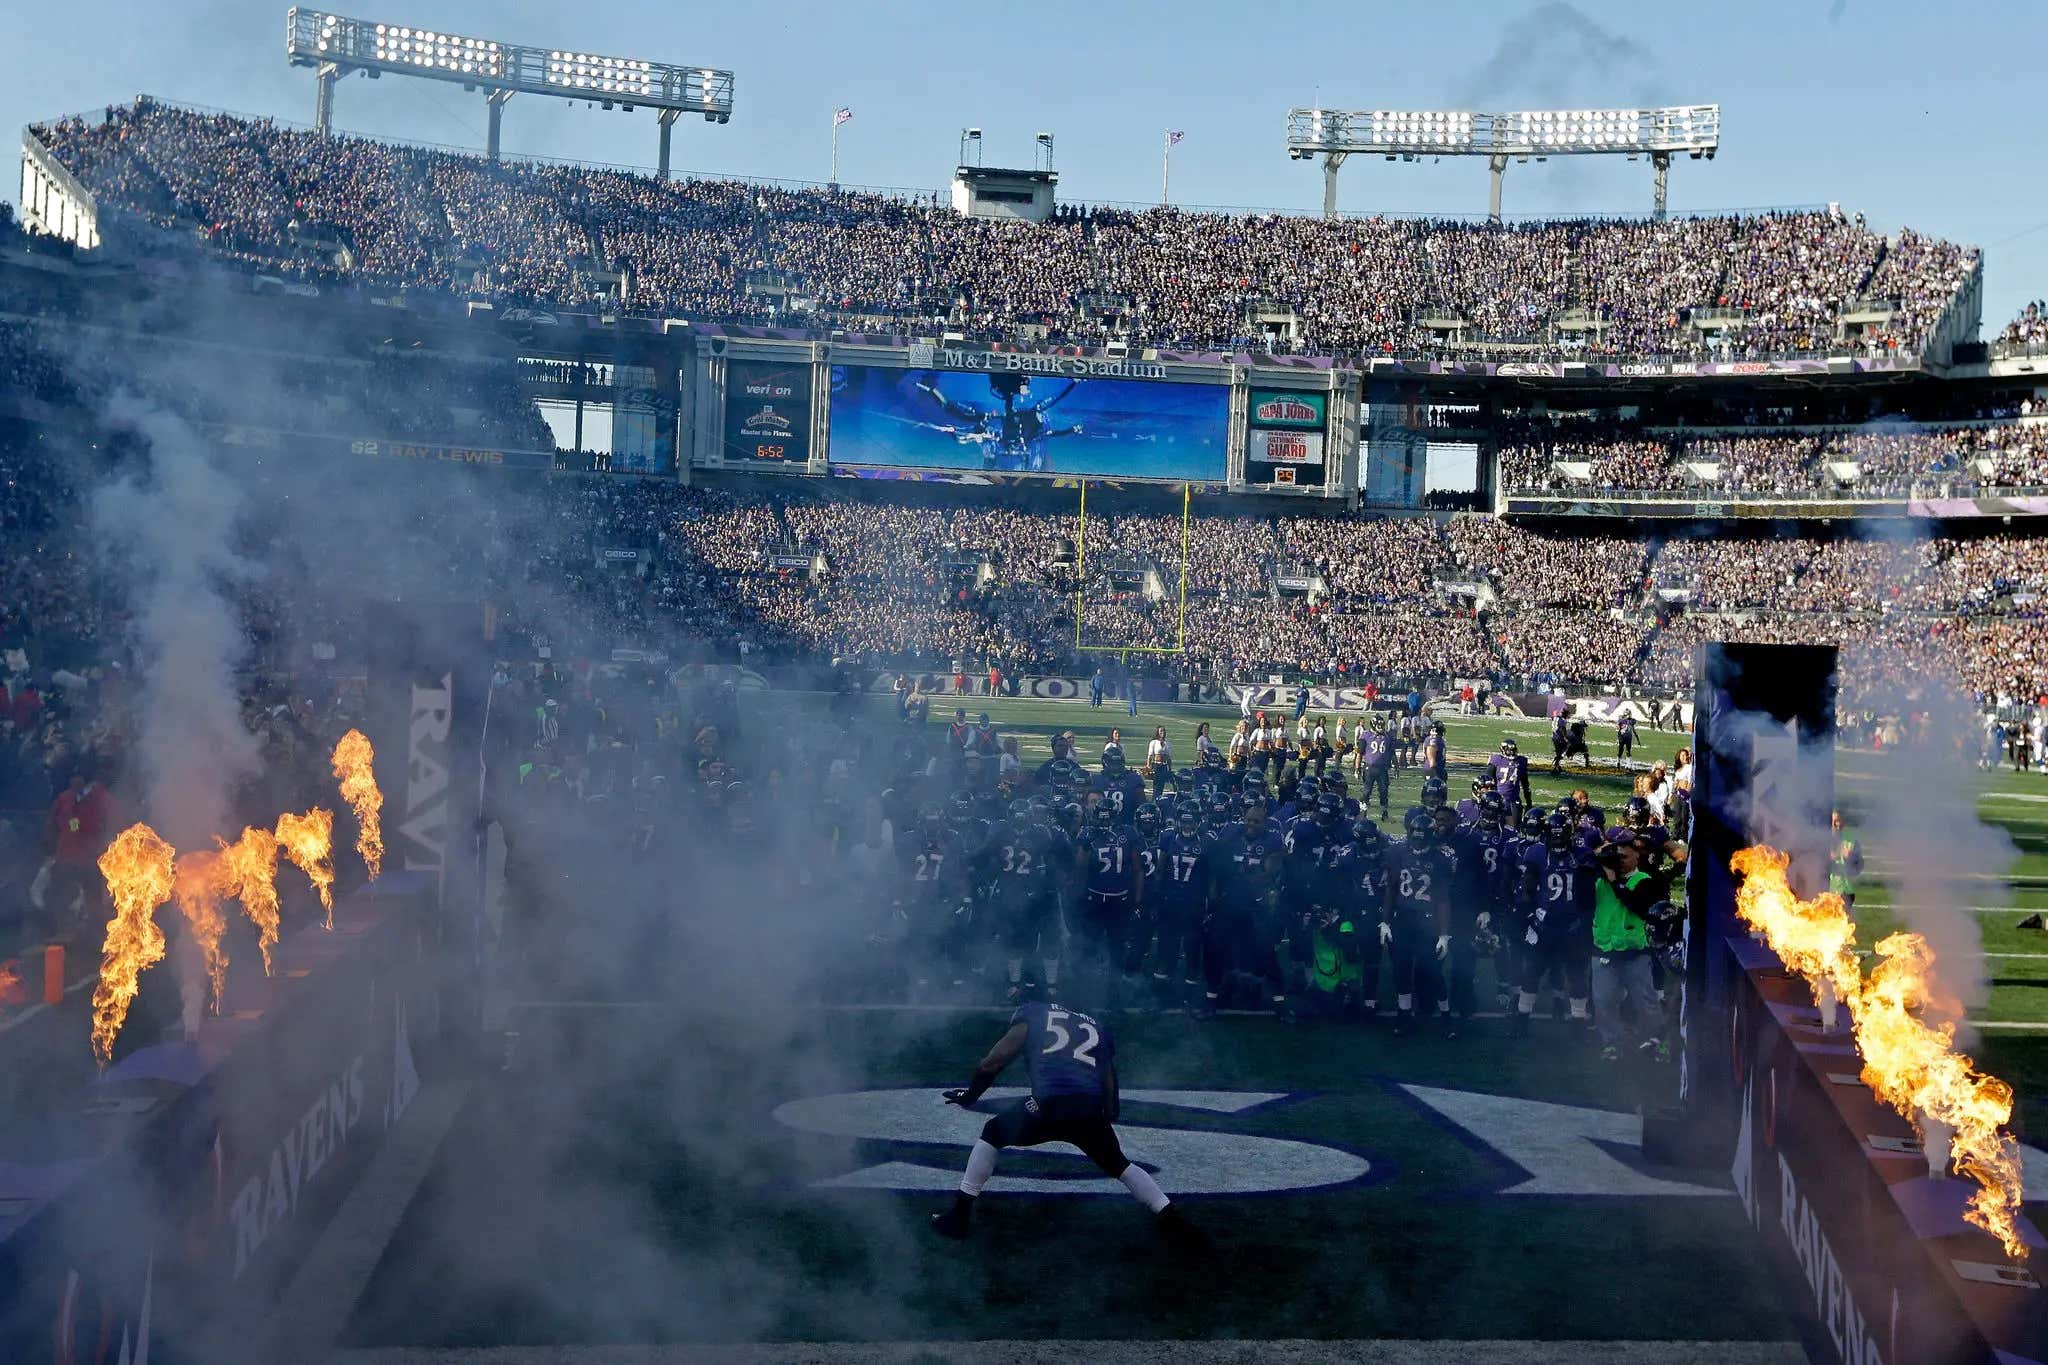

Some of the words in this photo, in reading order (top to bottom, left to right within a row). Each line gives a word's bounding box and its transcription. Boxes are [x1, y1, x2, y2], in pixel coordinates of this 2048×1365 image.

[943, 349, 997, 369] M&T
[1005, 353, 1065, 375] Bank
[1072, 357, 1169, 379] Stadium
[1259, 403, 1283, 419] PAPA
[438, 447, 504, 465] LEWIS
[757, 446, 785, 459] 6:52
[1266, 443, 1307, 457] GUARD
[778, 558, 809, 566] GEICO
[1370, 740, 1387, 754] 96
[1002, 846, 1032, 874] 32
[1098, 847, 1123, 874] 51
[1172, 855, 1197, 882] 17
[1400, 868, 1431, 901] 82
[1547, 873, 1574, 901] 91
[1042, 1010, 1100, 1068] 52
[228, 1052, 365, 1282] RAVENS
